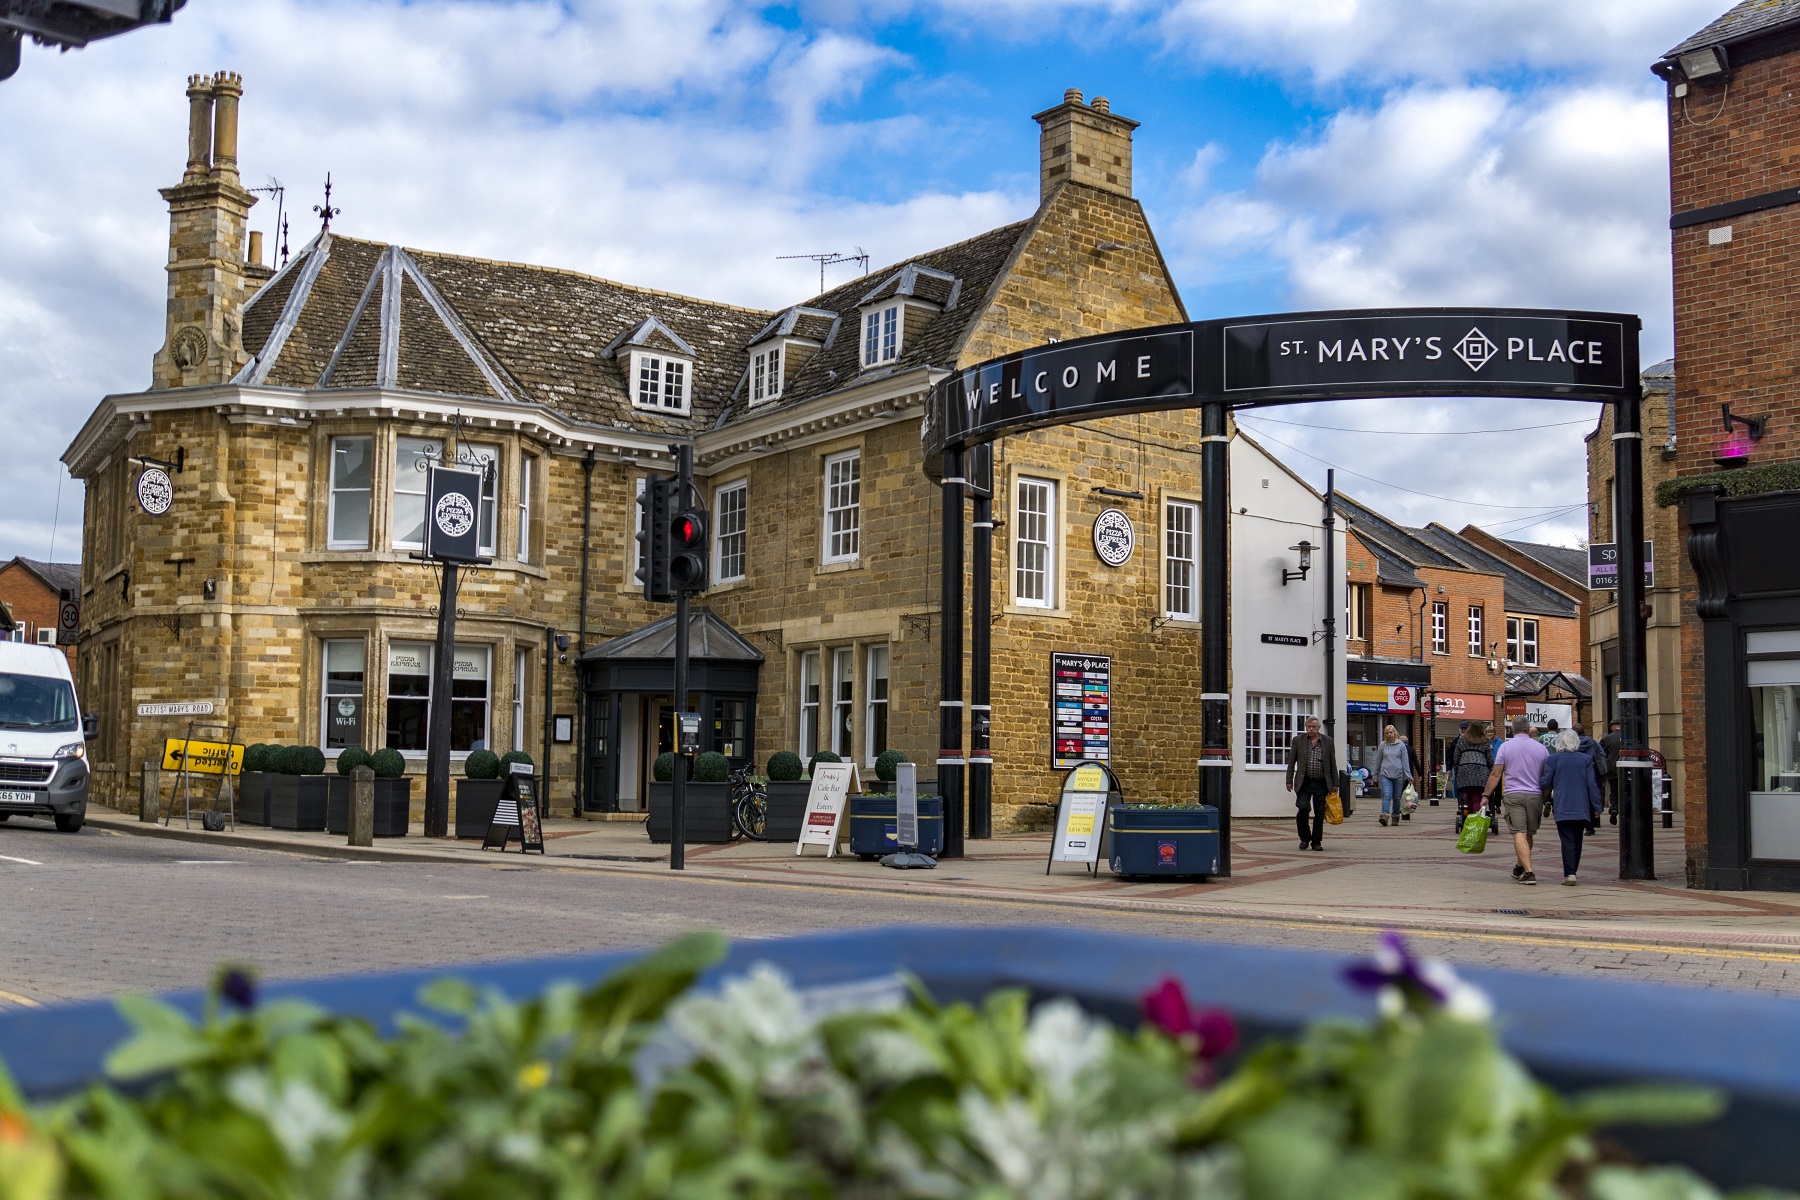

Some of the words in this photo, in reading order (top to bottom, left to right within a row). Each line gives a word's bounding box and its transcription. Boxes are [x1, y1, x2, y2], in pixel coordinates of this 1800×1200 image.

[1280, 341, 1308, 355] ST.
[1318, 336, 1442, 364] MARY'S
[1507, 337, 1604, 365] PLACE
[966, 355, 1151, 411] WELCOME
[441, 512, 468, 520] EXPRESS
[1105, 529, 1123, 537] PIZZA
[1101, 535, 1127, 544] EXPRESS
[64, 611, 77, 621] 30
[1061, 660, 1083, 668] MARY'S
[140, 706, 157, 714] A427
[192, 704, 209, 712] ROAD
[335, 717, 356, 726] Wi-Fi
[194, 758, 238, 769] Dverted
[817, 784, 829, 792] Cafe
[830, 784, 840, 792] Bar
[15, 793, 32, 801] YOH
[823, 793, 829, 801] &
[816, 803, 833, 811] Eatery
